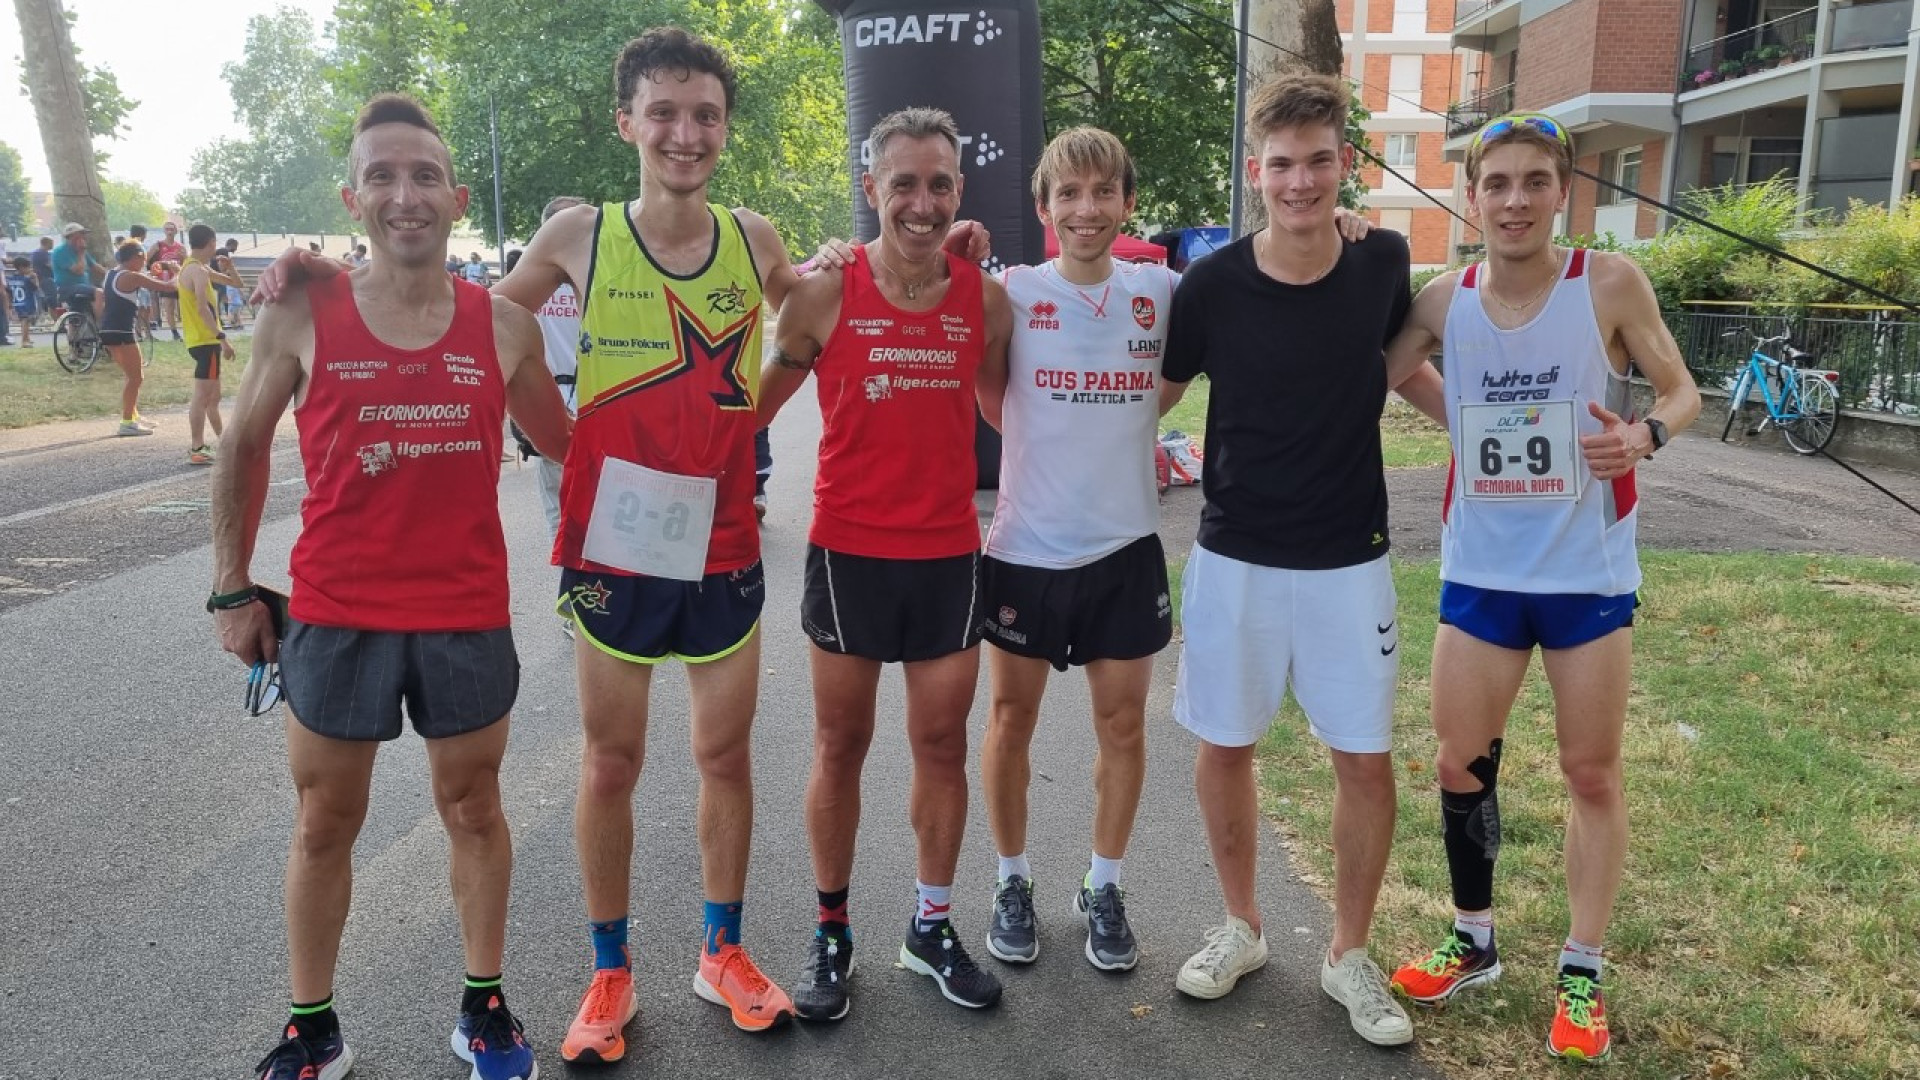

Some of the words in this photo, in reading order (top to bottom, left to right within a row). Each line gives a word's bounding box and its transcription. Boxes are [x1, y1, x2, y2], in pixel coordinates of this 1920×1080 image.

[856, 13, 970, 47] CRAFT
[618, 291, 654, 299] PISSEI
[902, 325, 926, 336] GORE
[598, 337, 629, 347] Bruno
[443, 353, 475, 364] Circolo
[398, 363, 428, 375] GORE
[447, 364, 485, 377] Minerva
[893, 376, 961, 391] ilger.com
[1034, 368, 1077, 390] CUS
[1083, 371, 1155, 391] PARMA
[1481, 369, 1533, 388] tutto
[1536, 365, 1561, 385] di
[1071, 392, 1126, 404] ATLETICA
[397, 440, 482, 458] ilger.com
[1480, 436, 1551, 476] 6-9
[1474, 479, 1528, 494] MEMORIAL
[1531, 478, 1564, 493] RUFFO
